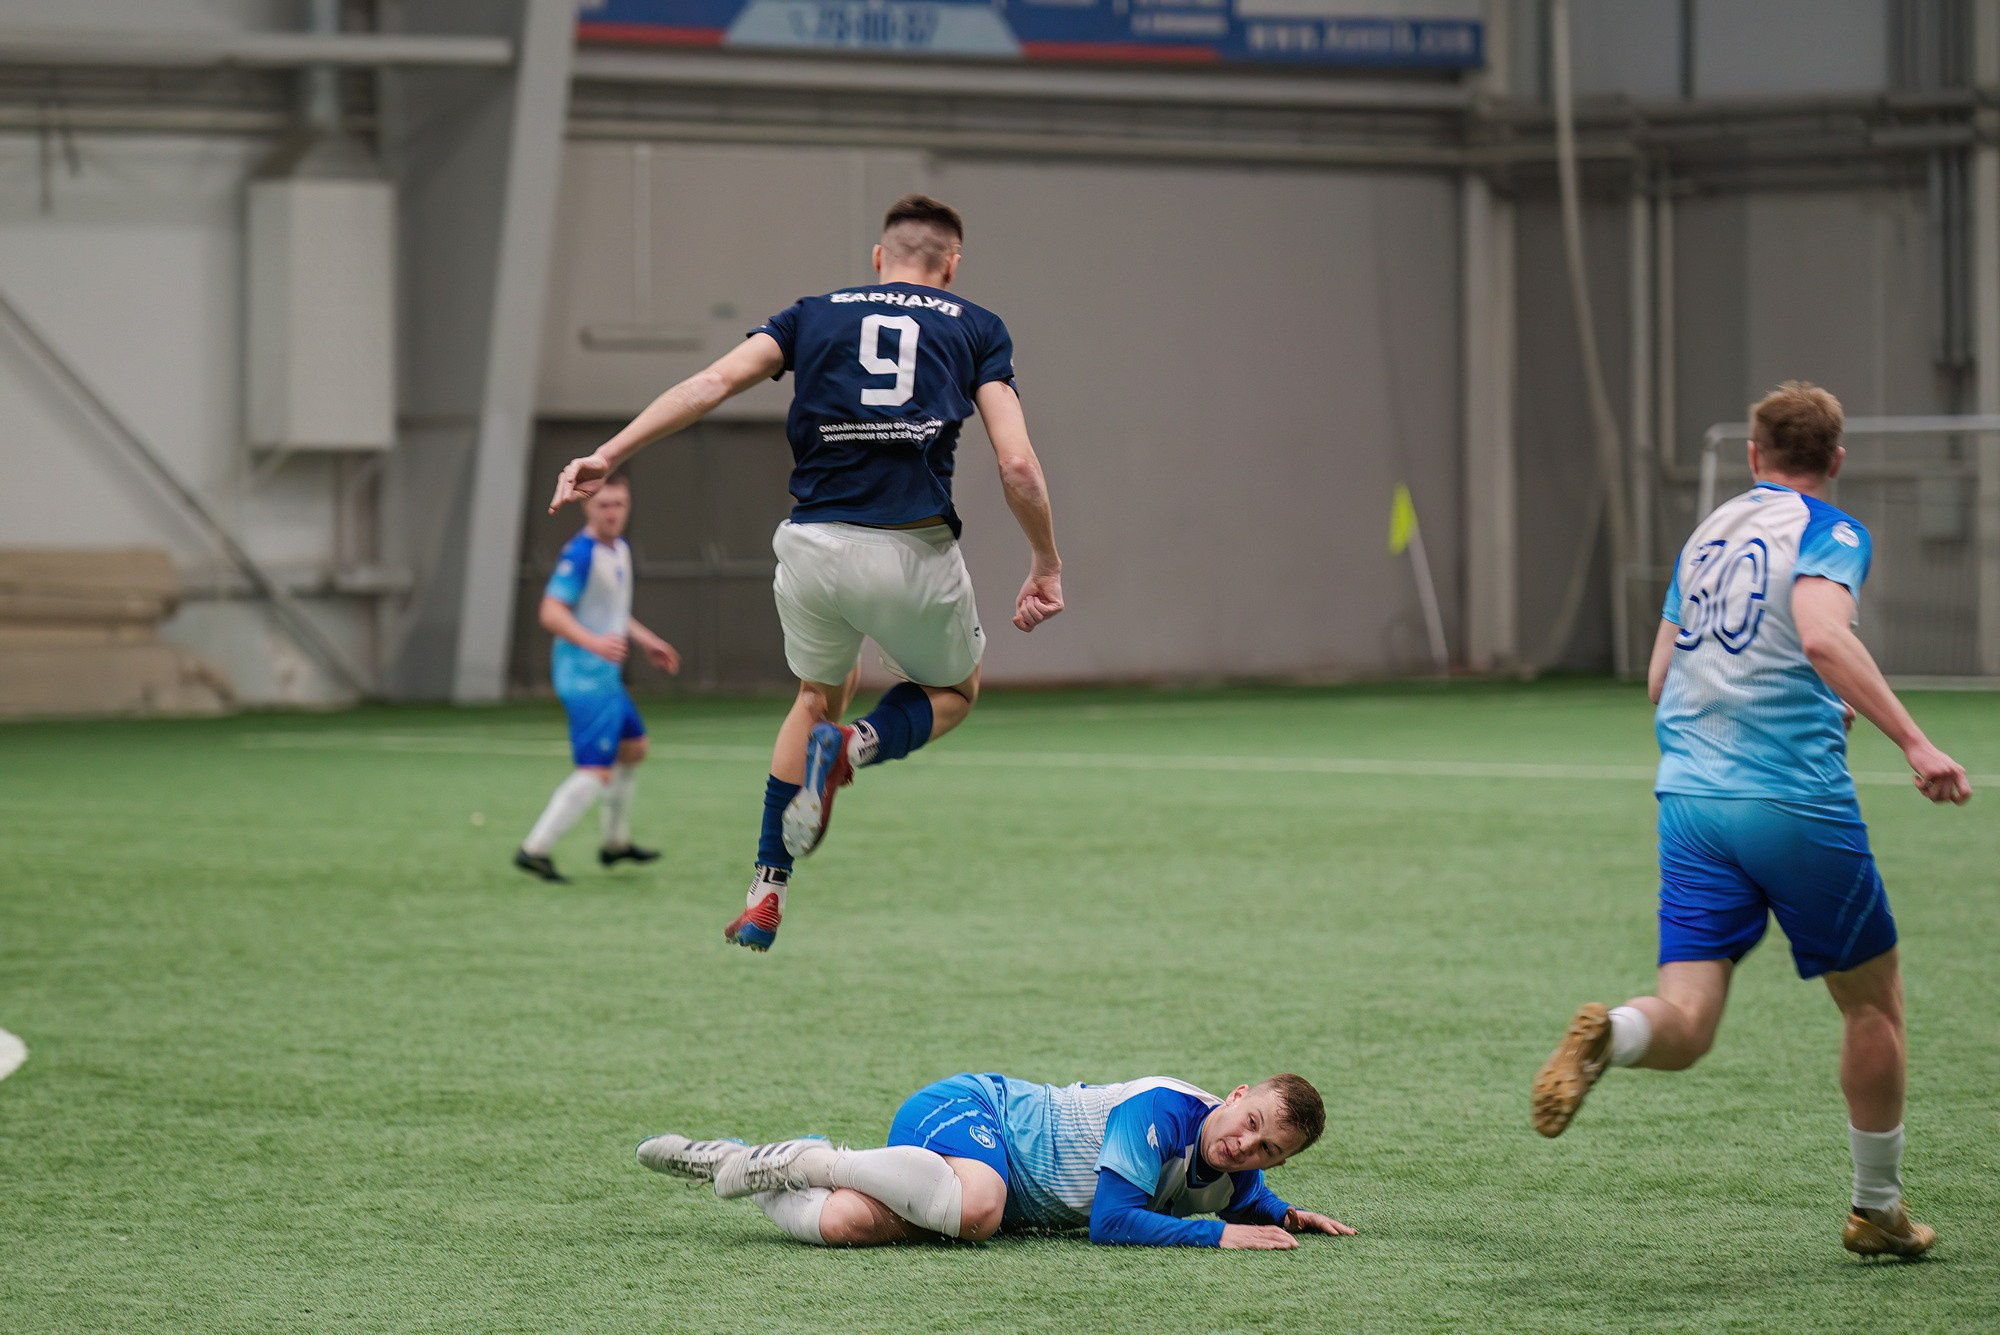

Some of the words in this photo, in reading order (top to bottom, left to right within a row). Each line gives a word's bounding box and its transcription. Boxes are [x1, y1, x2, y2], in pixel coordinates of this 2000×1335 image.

[830, 292, 963, 317] БАРНАУЛ
[858, 314, 920, 407] 9
[890, 430, 912, 440] ВСЕЙ
[1674, 537, 1768, 654] 30
